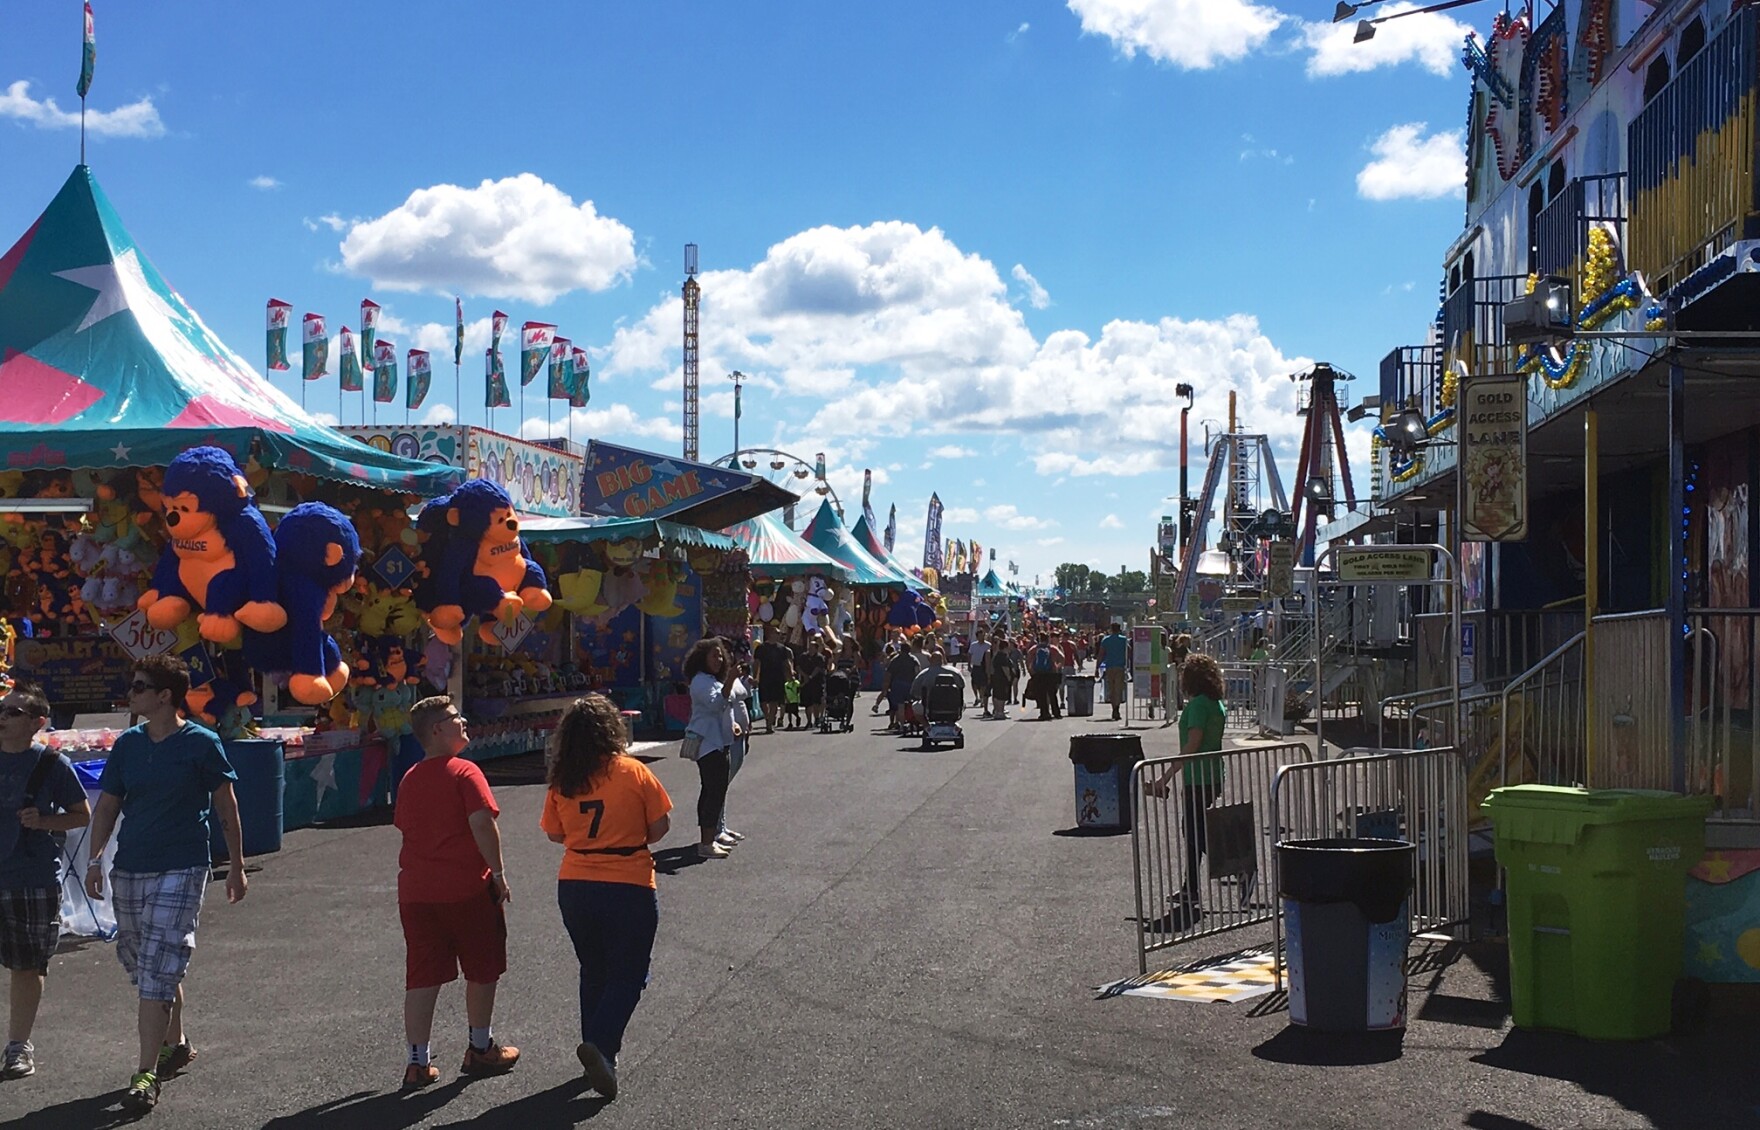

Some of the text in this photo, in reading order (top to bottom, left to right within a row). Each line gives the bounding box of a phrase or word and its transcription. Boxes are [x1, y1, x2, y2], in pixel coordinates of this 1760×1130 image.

[1477, 393, 1513, 405] GOLD
[1469, 411, 1521, 424] ACCESS
[1467, 431, 1521, 446] LANE
[596, 458, 653, 497] BIG
[623, 470, 704, 517] GAME
[386, 560, 403, 574] $1
[1342, 555, 1365, 566] GOLD
[1402, 554, 1425, 564] LANE
[1463, 629, 1470, 646] 4
[579, 799, 605, 839] 7
